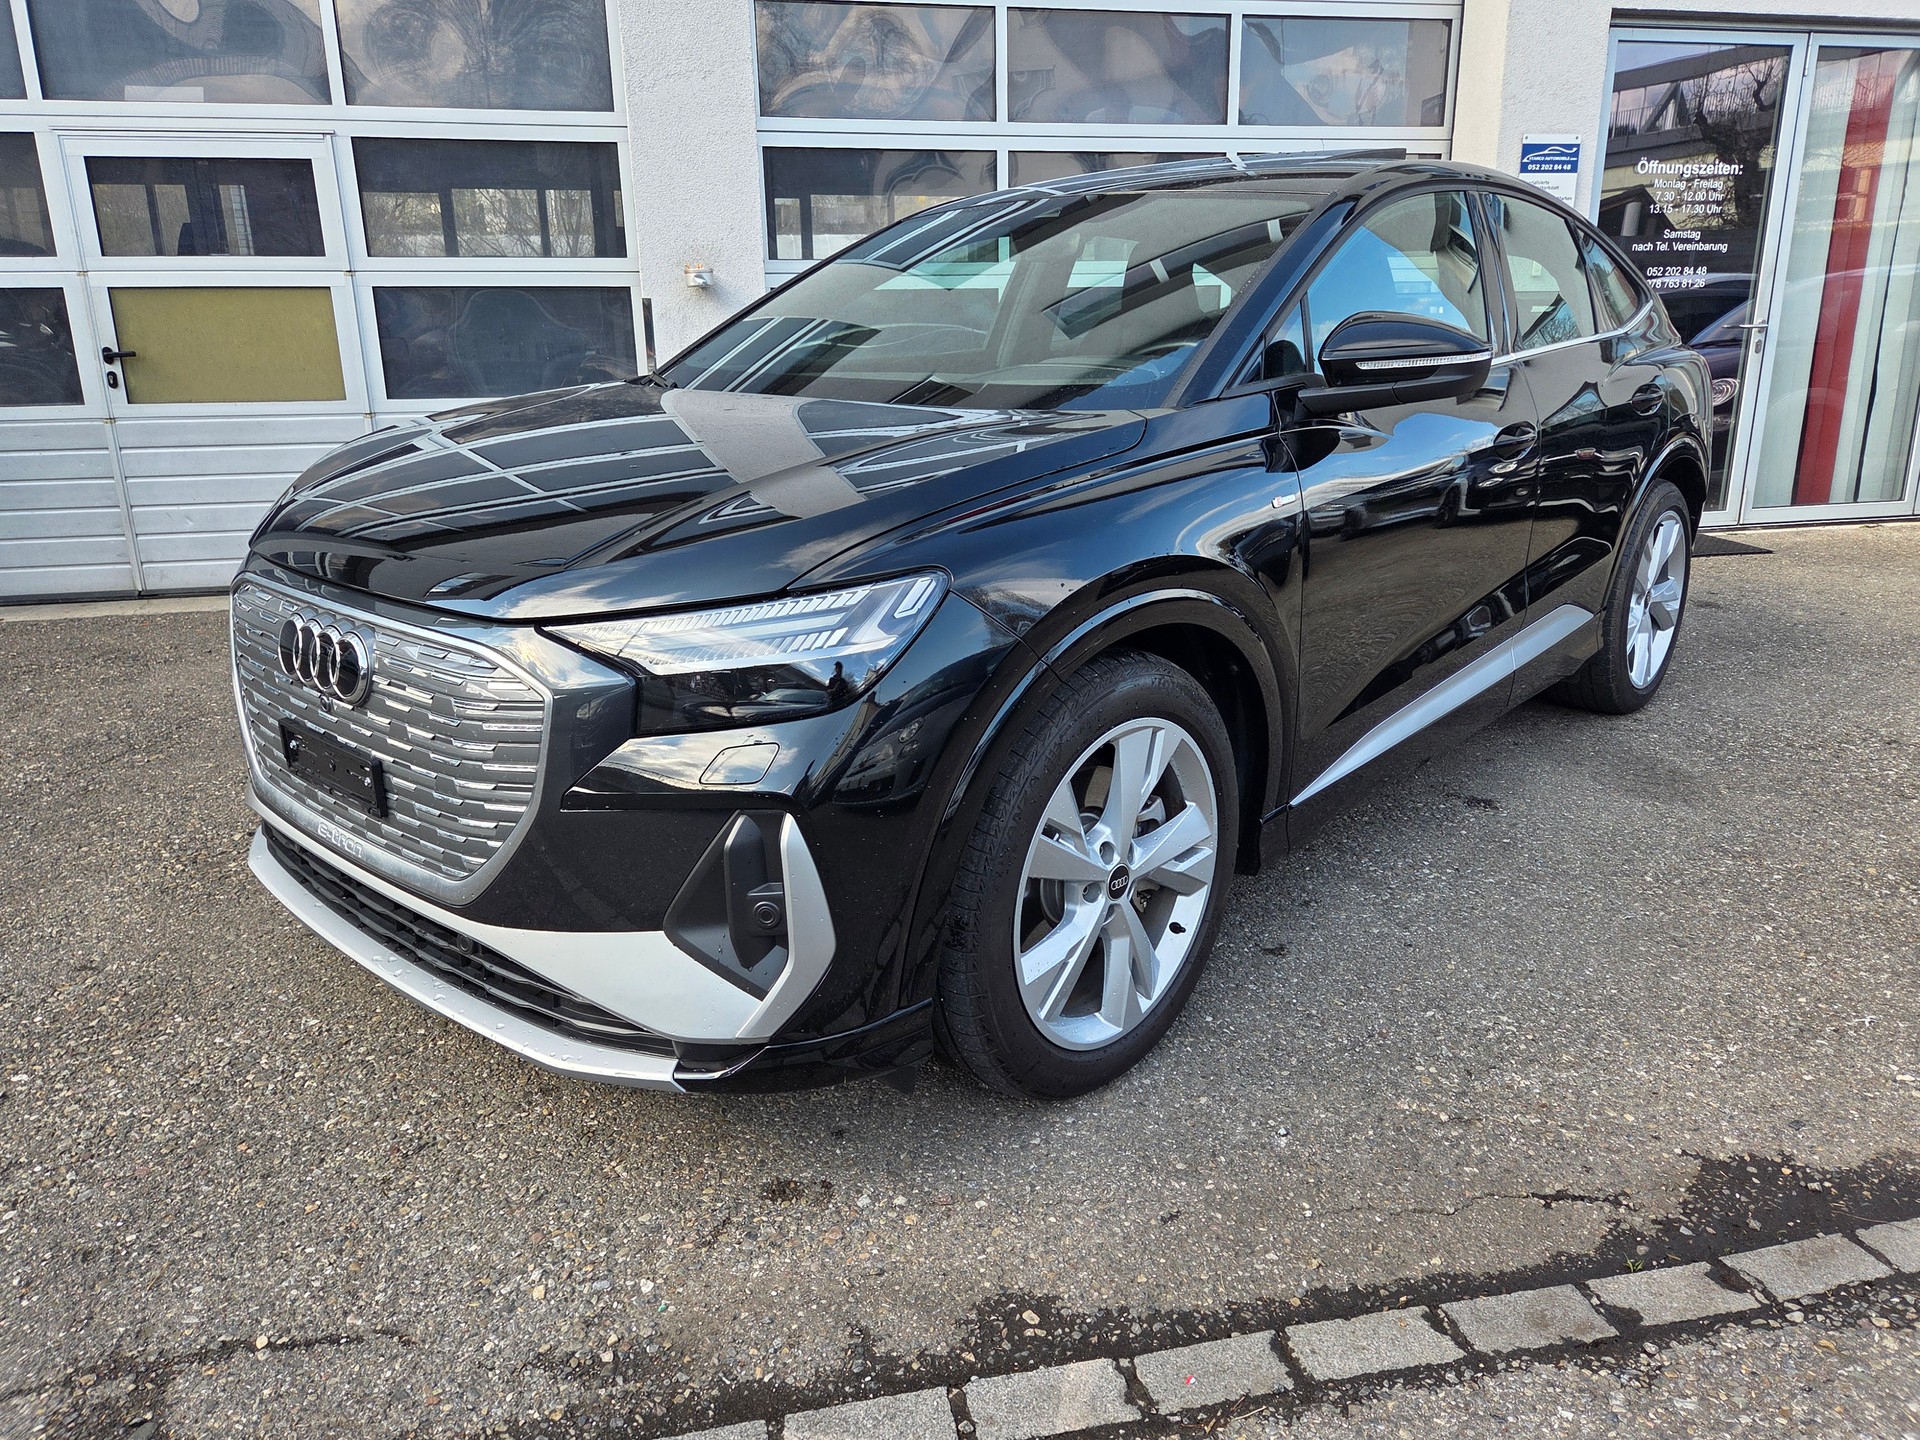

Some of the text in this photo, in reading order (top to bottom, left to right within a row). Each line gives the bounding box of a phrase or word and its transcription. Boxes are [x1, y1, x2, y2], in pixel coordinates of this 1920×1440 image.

[1637, 157, 1743, 177] Öffnungszeiten:
[1654, 179, 1686, 190] Montag
[1693, 179, 1723, 190] Freitag
[1656, 192, 1675, 201] 7.30
[1683, 191, 1706, 201] 12.00
[1708, 191, 1725, 201] Uhr
[1649, 204, 1673, 213] 13.15
[1682, 204, 1704, 213] 17.30
[1706, 204, 1722, 213] Uhr
[1663, 229, 1701, 240] Samstag
[1632, 241, 1728, 253] nach Tel. Vereinbarung
[1647, 266, 1707, 276] 052 202 84 48
[1663, 280, 1680, 288] 763
[1682, 280, 1691, 288] 81
[1694, 279, 1706, 288] 26
[317, 821, 364, 859] e-tron
